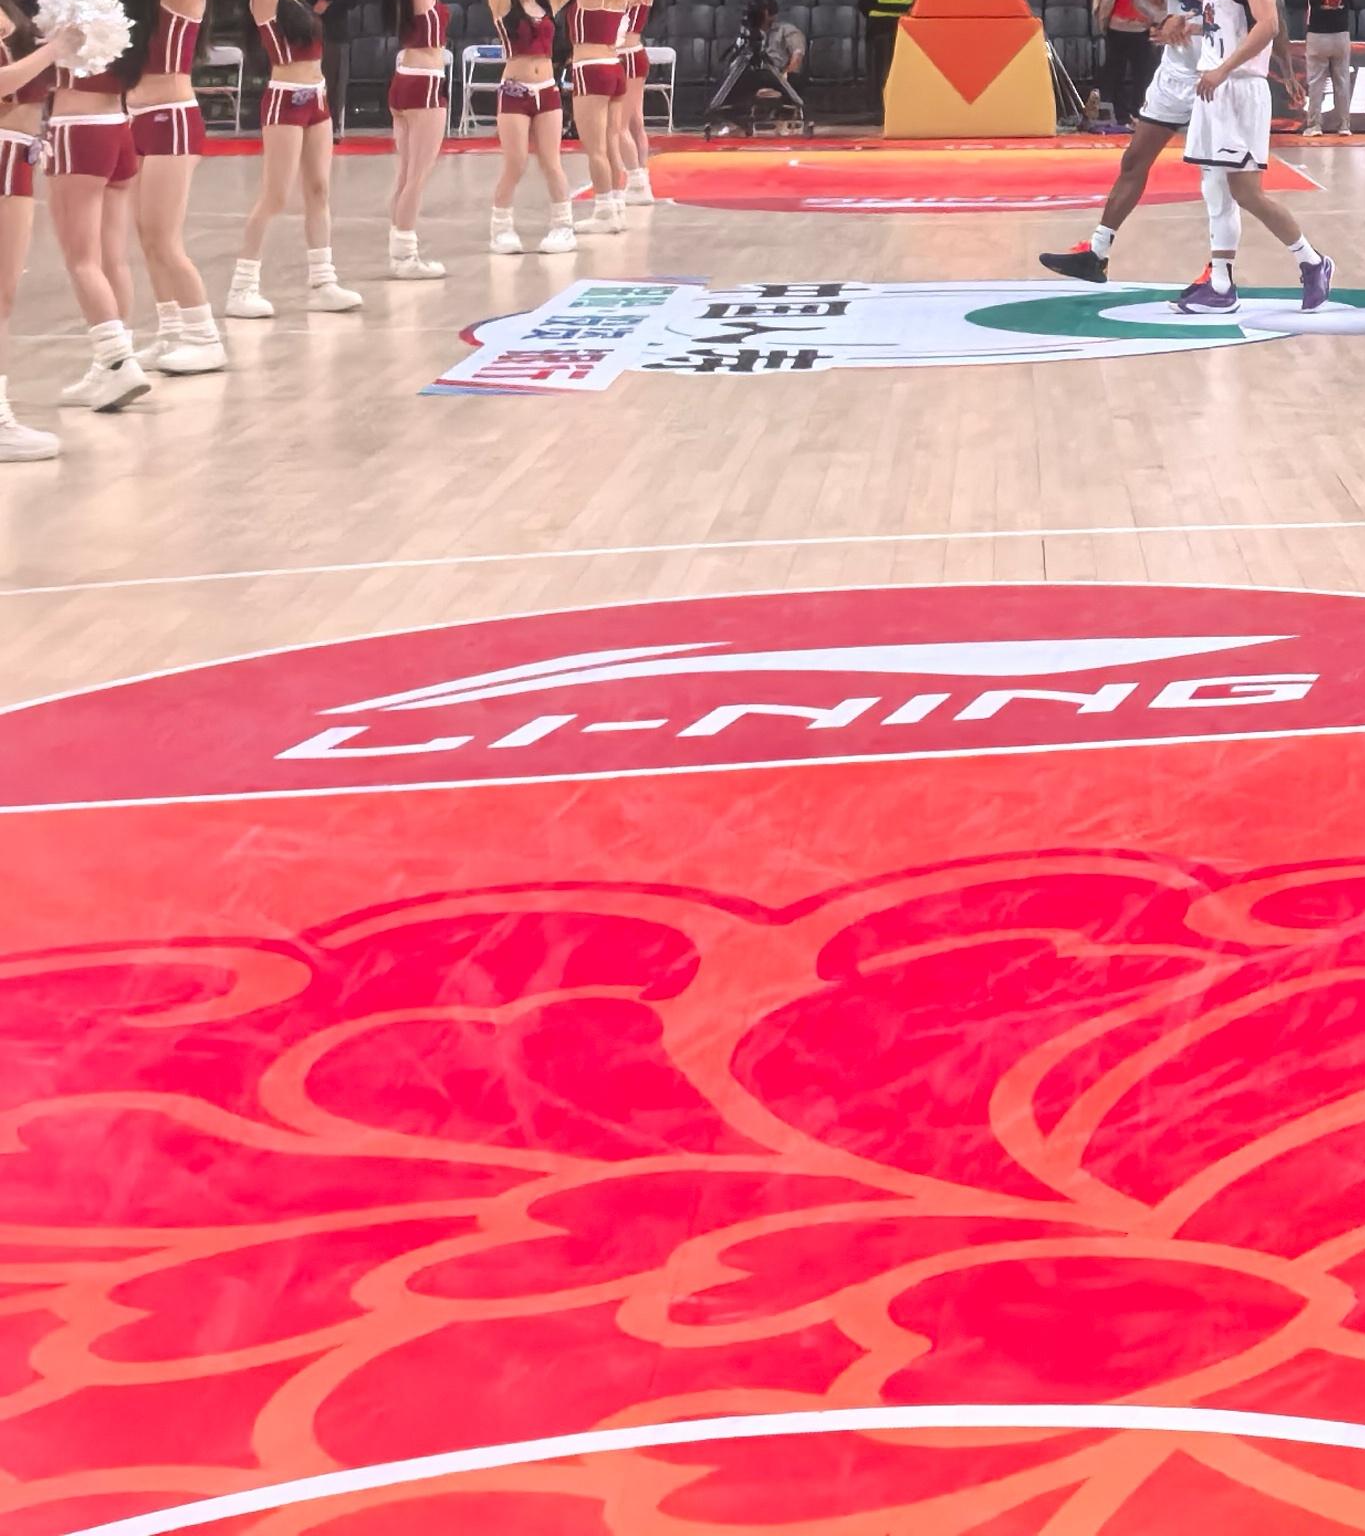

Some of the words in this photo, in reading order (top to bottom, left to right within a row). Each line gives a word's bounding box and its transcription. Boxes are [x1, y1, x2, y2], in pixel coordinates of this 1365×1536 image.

[641, 282, 870, 373] 中国人寿
[273, 673, 1320, 761] LI-NING
